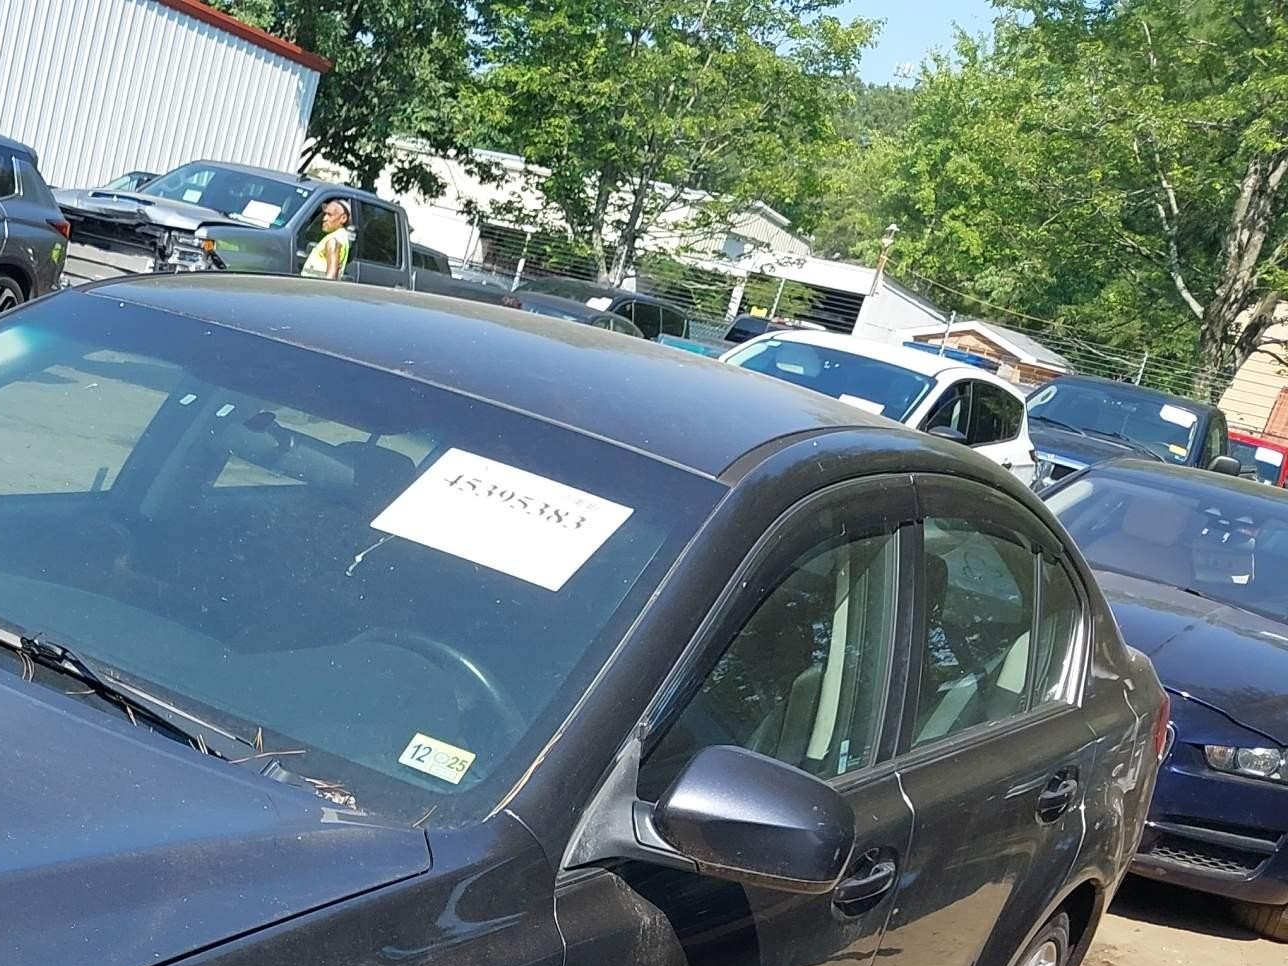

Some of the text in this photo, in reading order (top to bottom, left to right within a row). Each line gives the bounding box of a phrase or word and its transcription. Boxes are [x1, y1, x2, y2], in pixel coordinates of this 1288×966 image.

[443, 474, 587, 529] 45395383
[410, 743, 468, 772] 12 25
